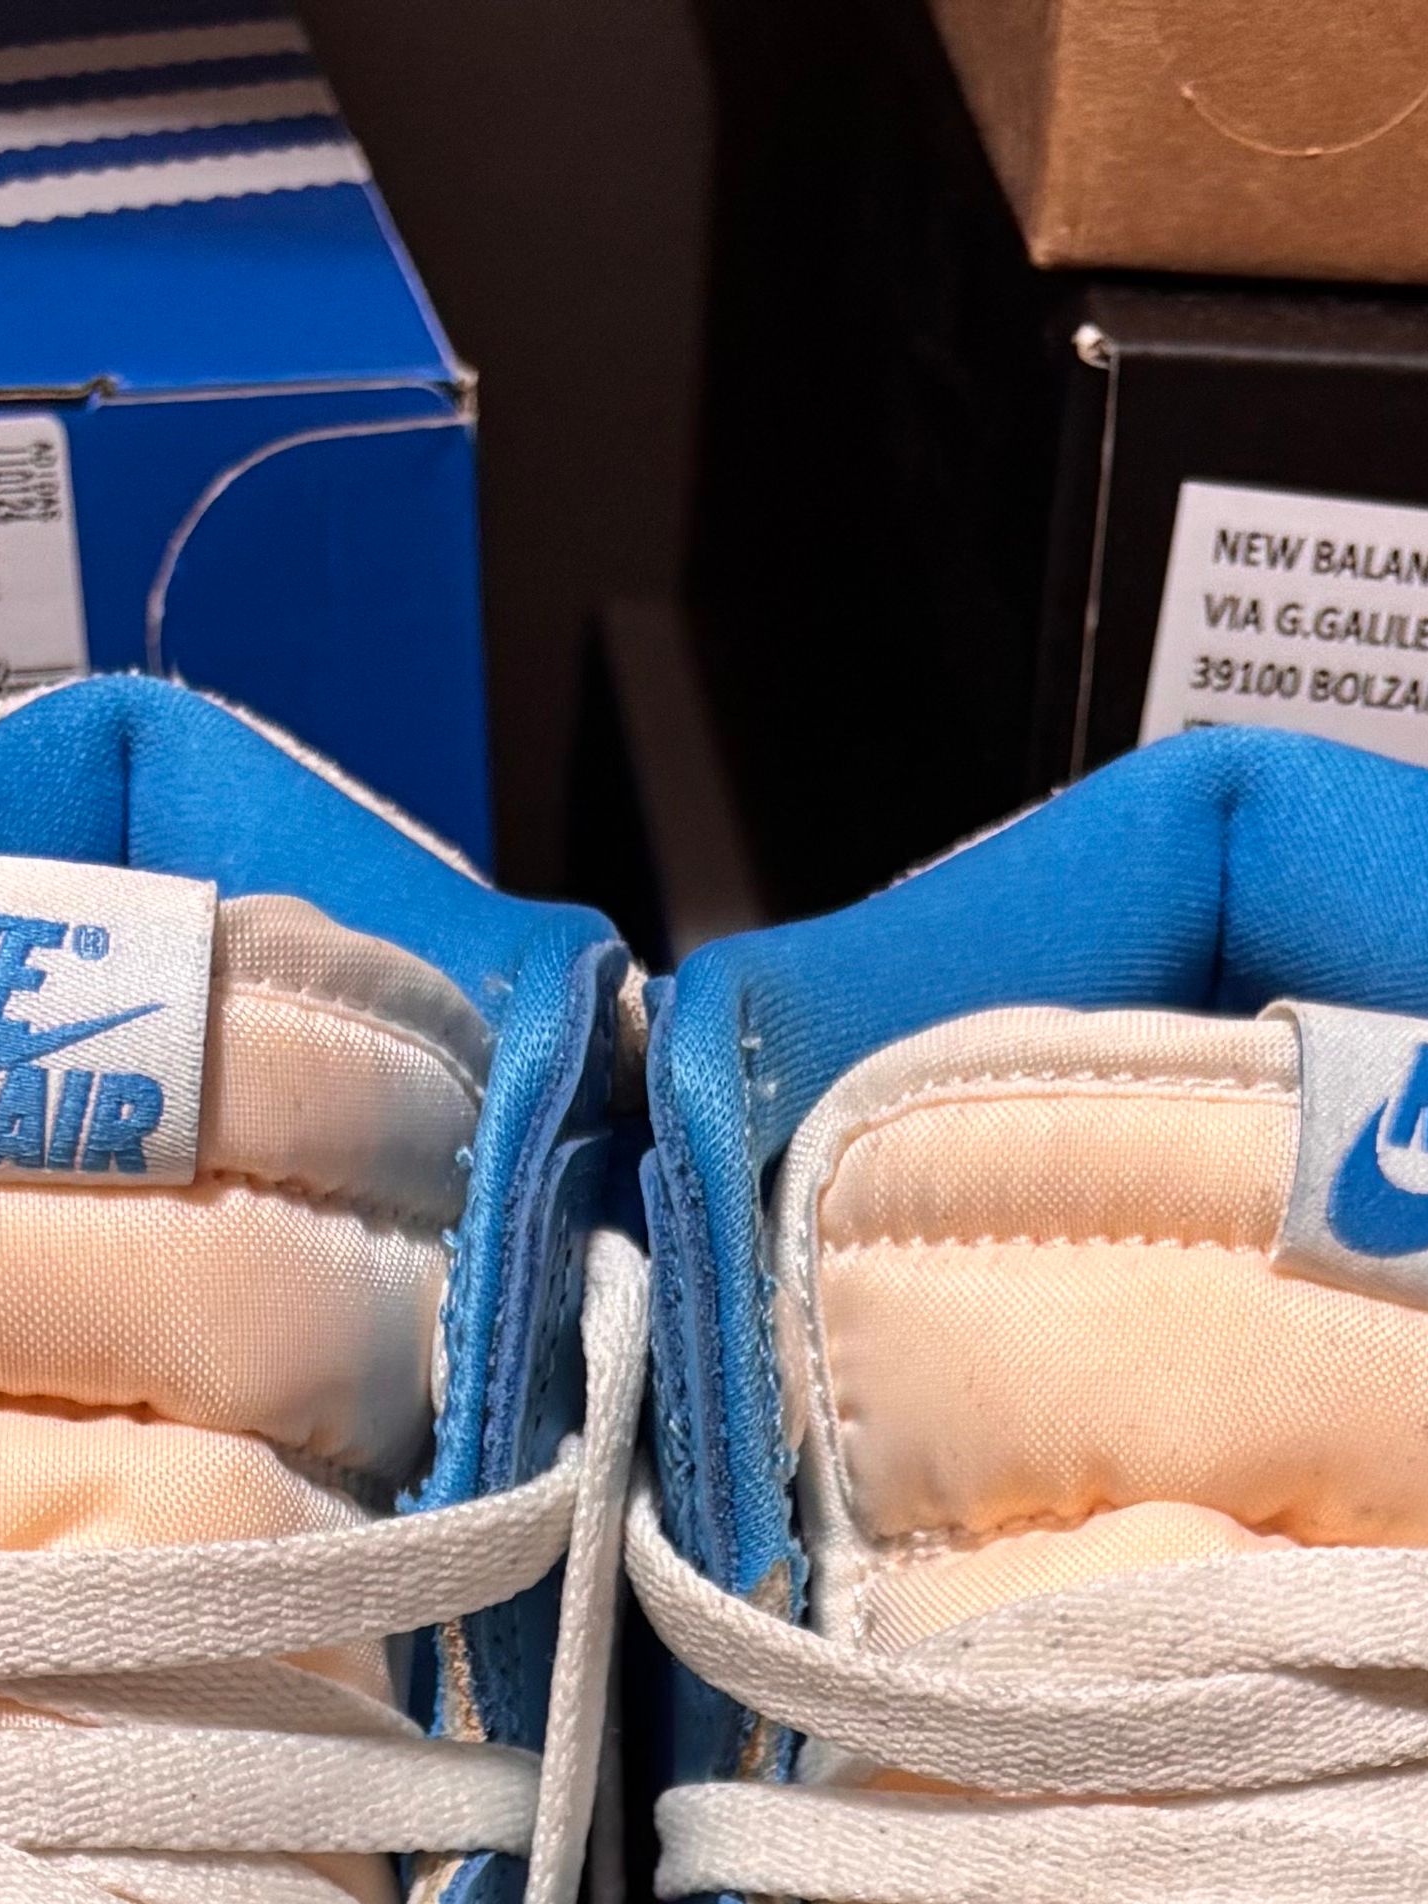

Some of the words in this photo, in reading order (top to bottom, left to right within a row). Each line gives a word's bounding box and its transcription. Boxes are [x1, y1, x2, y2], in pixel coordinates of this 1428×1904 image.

[1213, 526, 1305, 574] NEW
[1203, 592, 1262, 635] VIA
[1189, 654, 1298, 702] 39100
